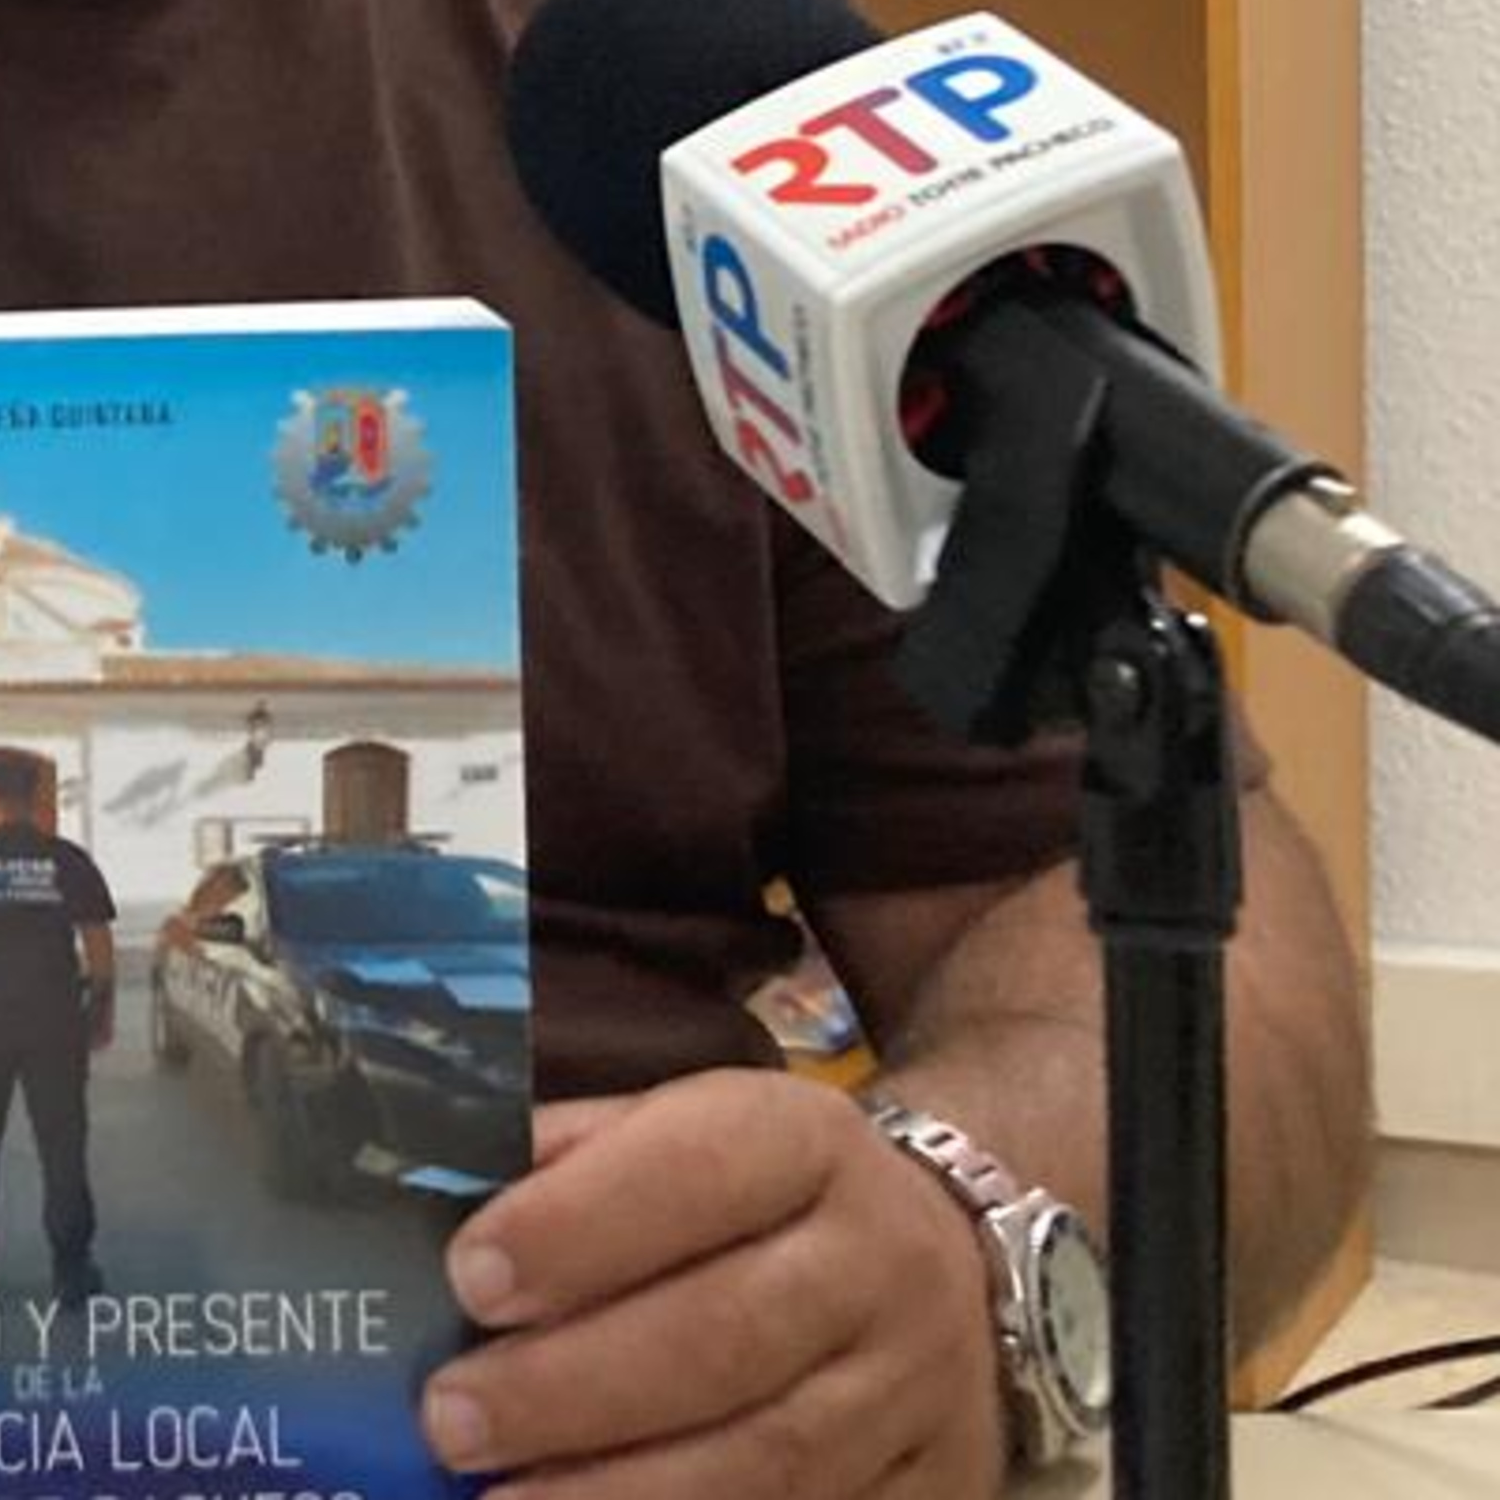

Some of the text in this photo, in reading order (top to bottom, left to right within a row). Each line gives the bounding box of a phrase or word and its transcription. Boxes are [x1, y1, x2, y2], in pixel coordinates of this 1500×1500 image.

[51, 399, 172, 428] QUINTANA
[25, 1298, 61, 1360] Y
[88, 1290, 388, 1361] PRESENTE
[14, 1364, 105, 1401] DE LA
[109, 1405, 301, 1470] LOCAL
